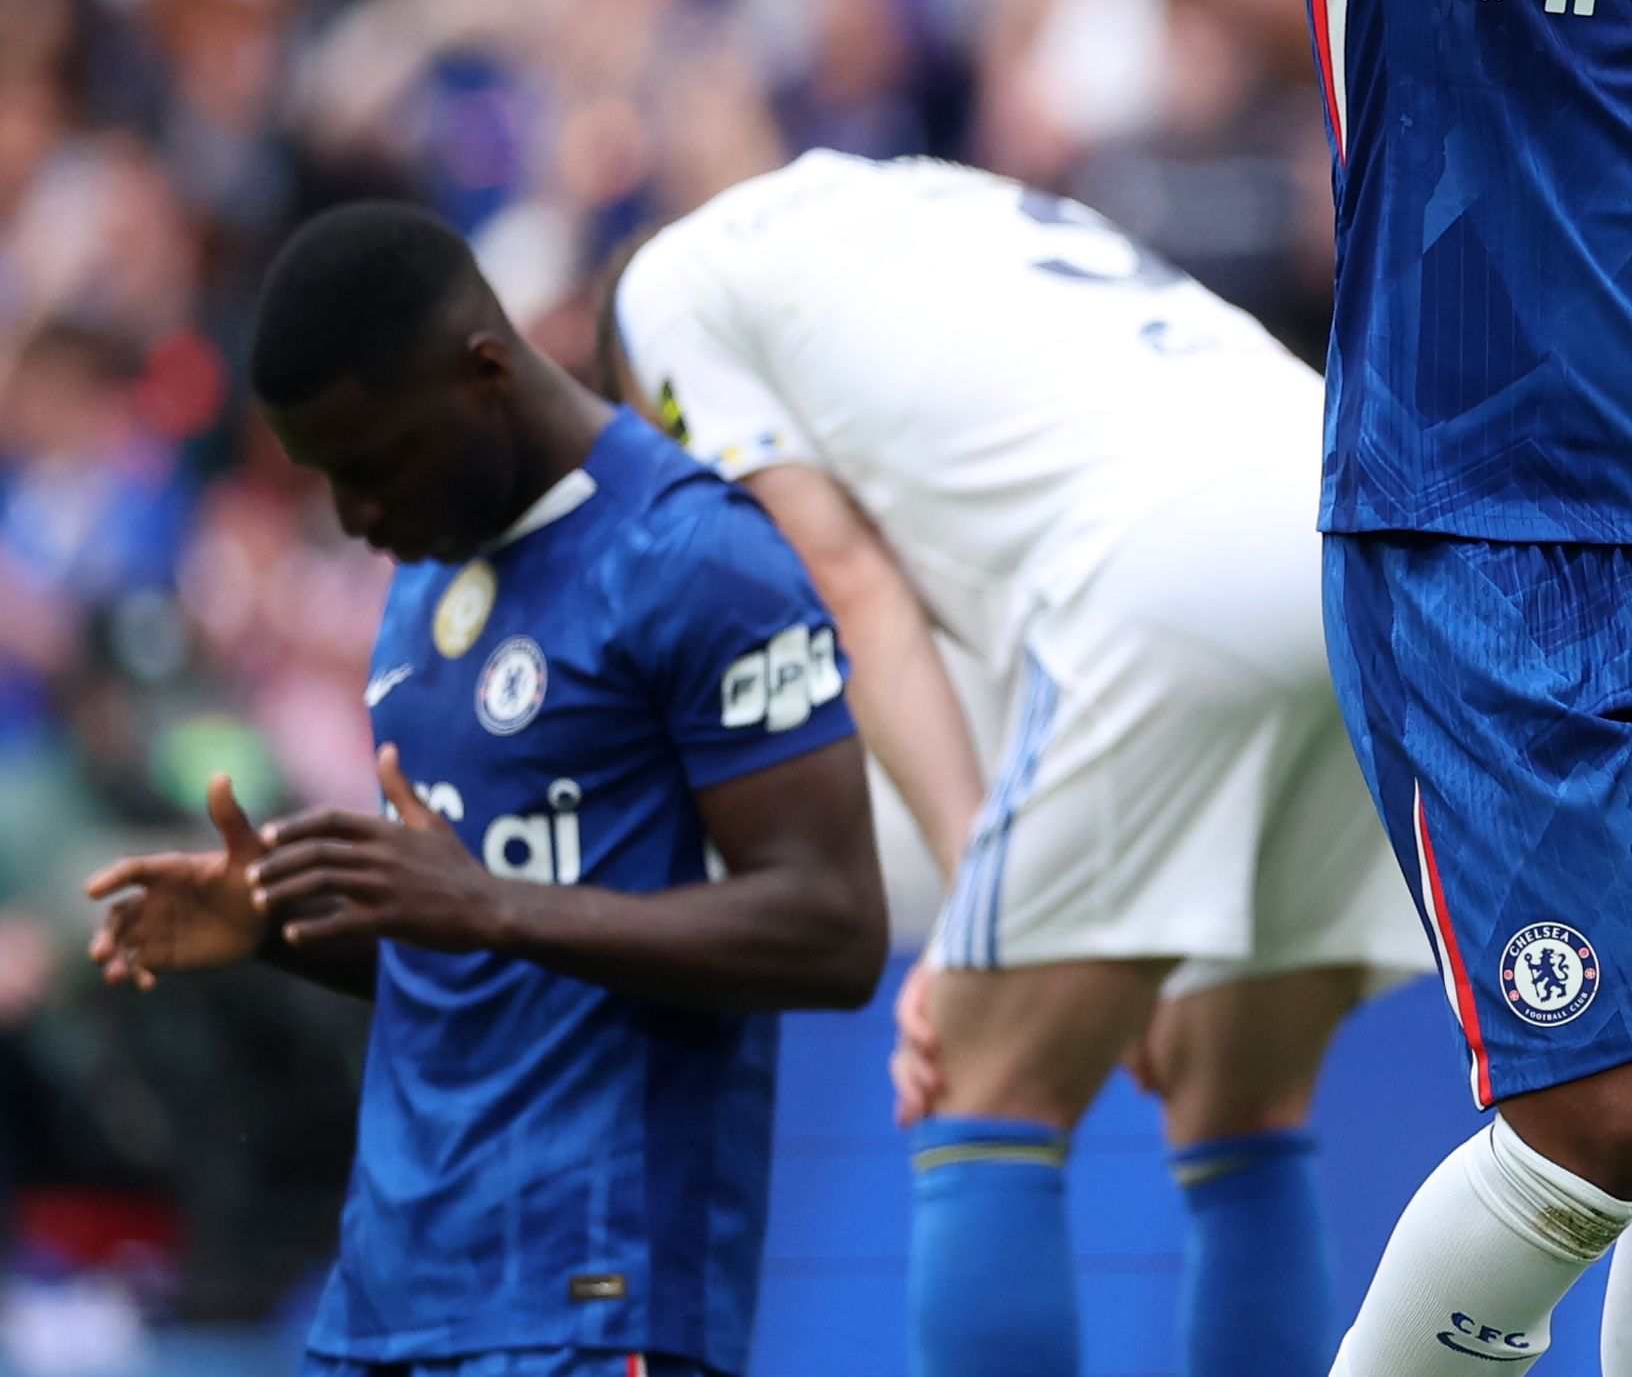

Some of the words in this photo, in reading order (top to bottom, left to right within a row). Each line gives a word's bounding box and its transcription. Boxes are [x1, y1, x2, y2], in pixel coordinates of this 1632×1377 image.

[1509, 926, 1570, 958] CHELSEA
[1524, 1008, 1568, 1022] FOOTBALL
[1569, 991, 1589, 1012] CLUB
[1451, 1310, 1531, 1350] CFC
